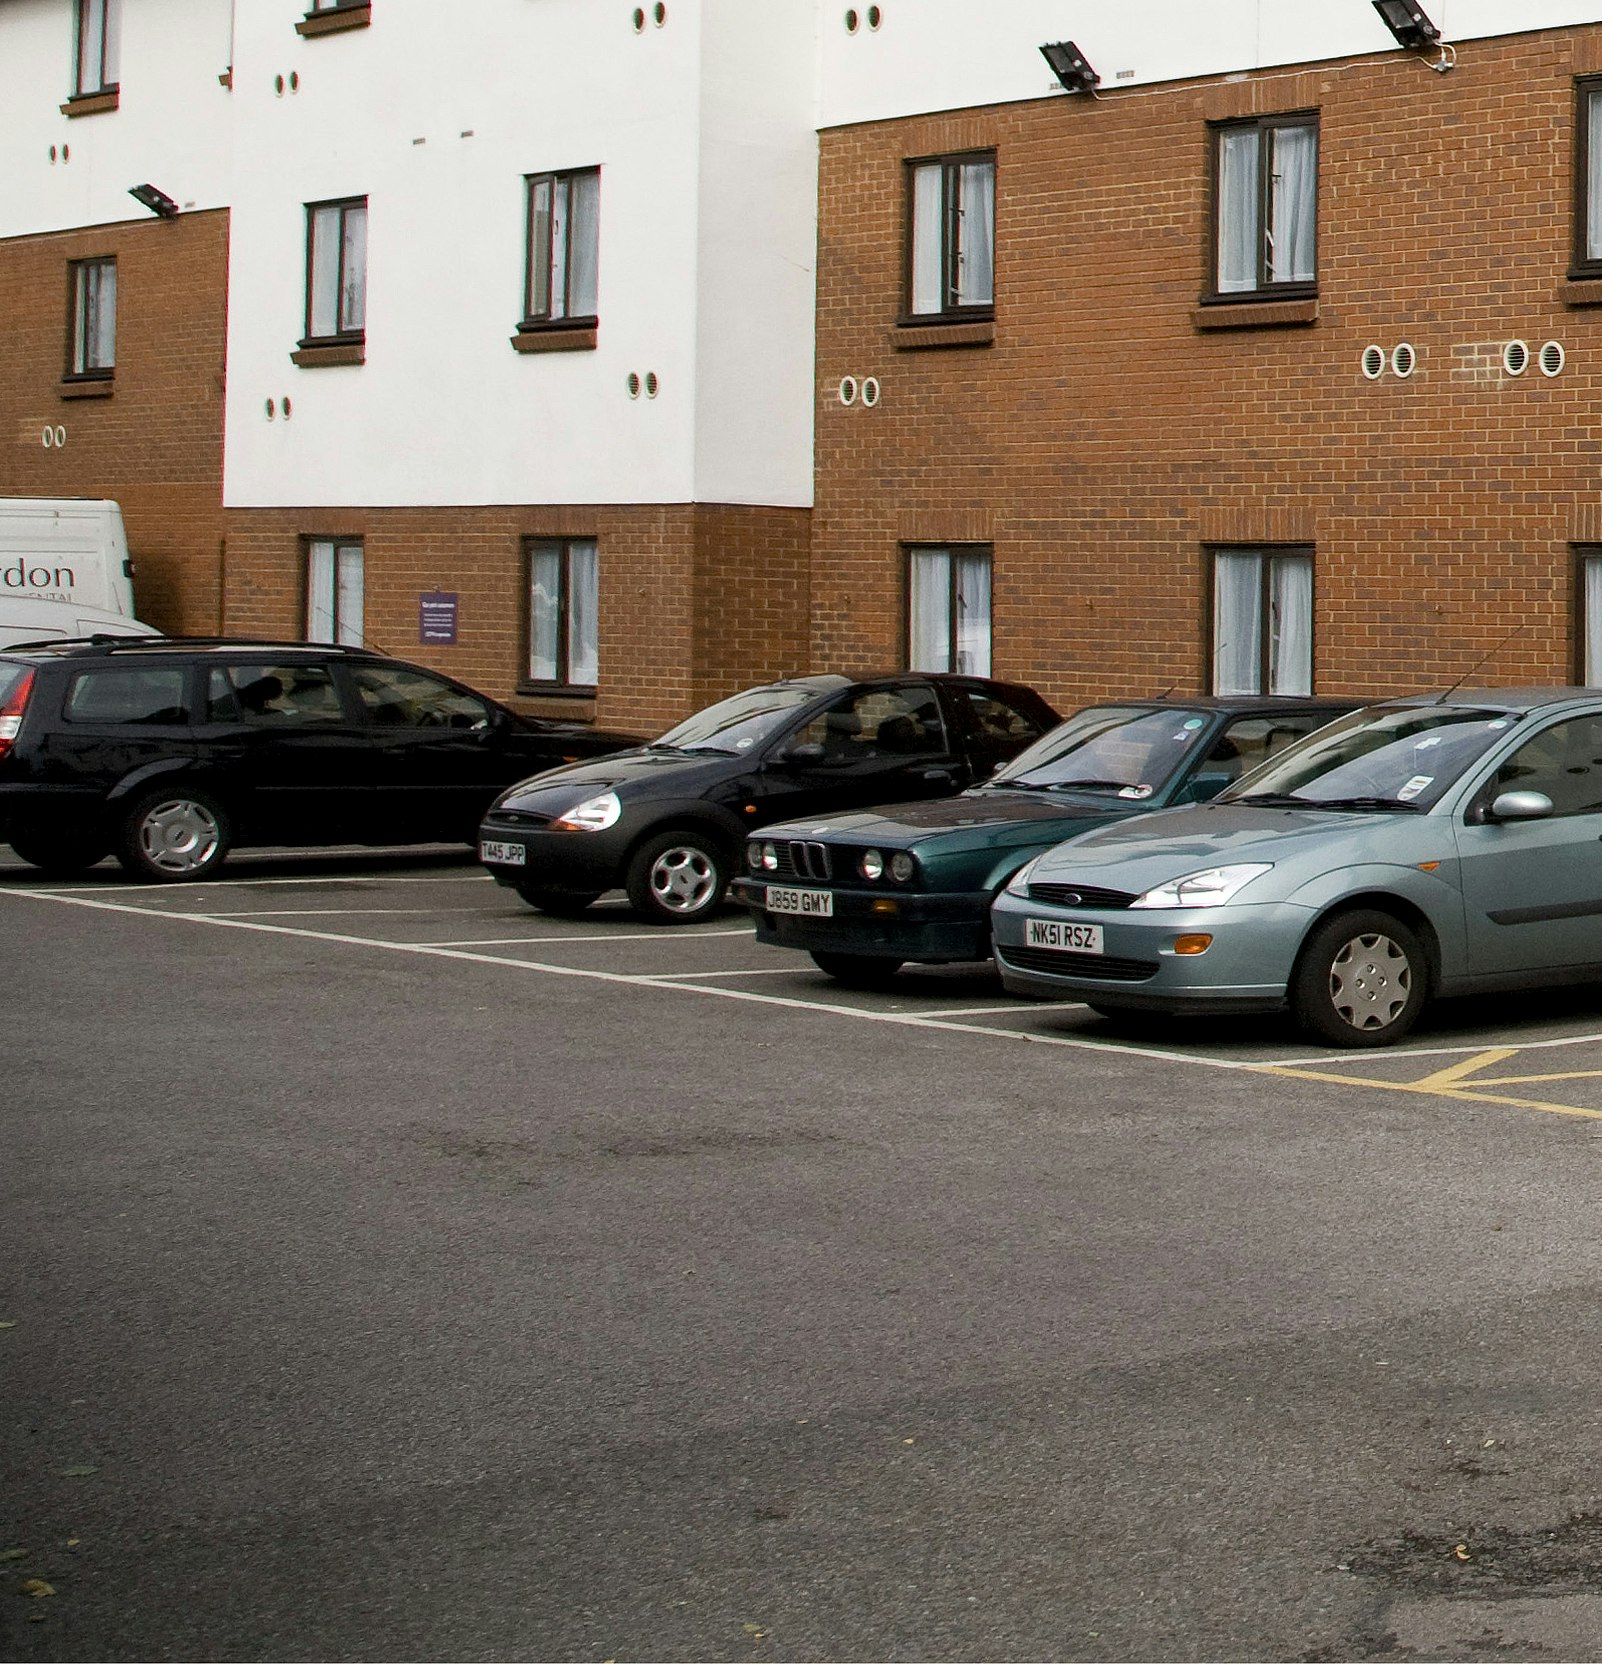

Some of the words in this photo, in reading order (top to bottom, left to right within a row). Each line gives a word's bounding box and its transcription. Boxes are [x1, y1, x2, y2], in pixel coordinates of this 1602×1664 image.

[0, 557, 75, 587] don
[505, 845, 523, 861] JPP
[802, 892, 830, 913] GMY
[1032, 922, 1061, 945] NK51
[1064, 925, 1093, 948] RSZ
